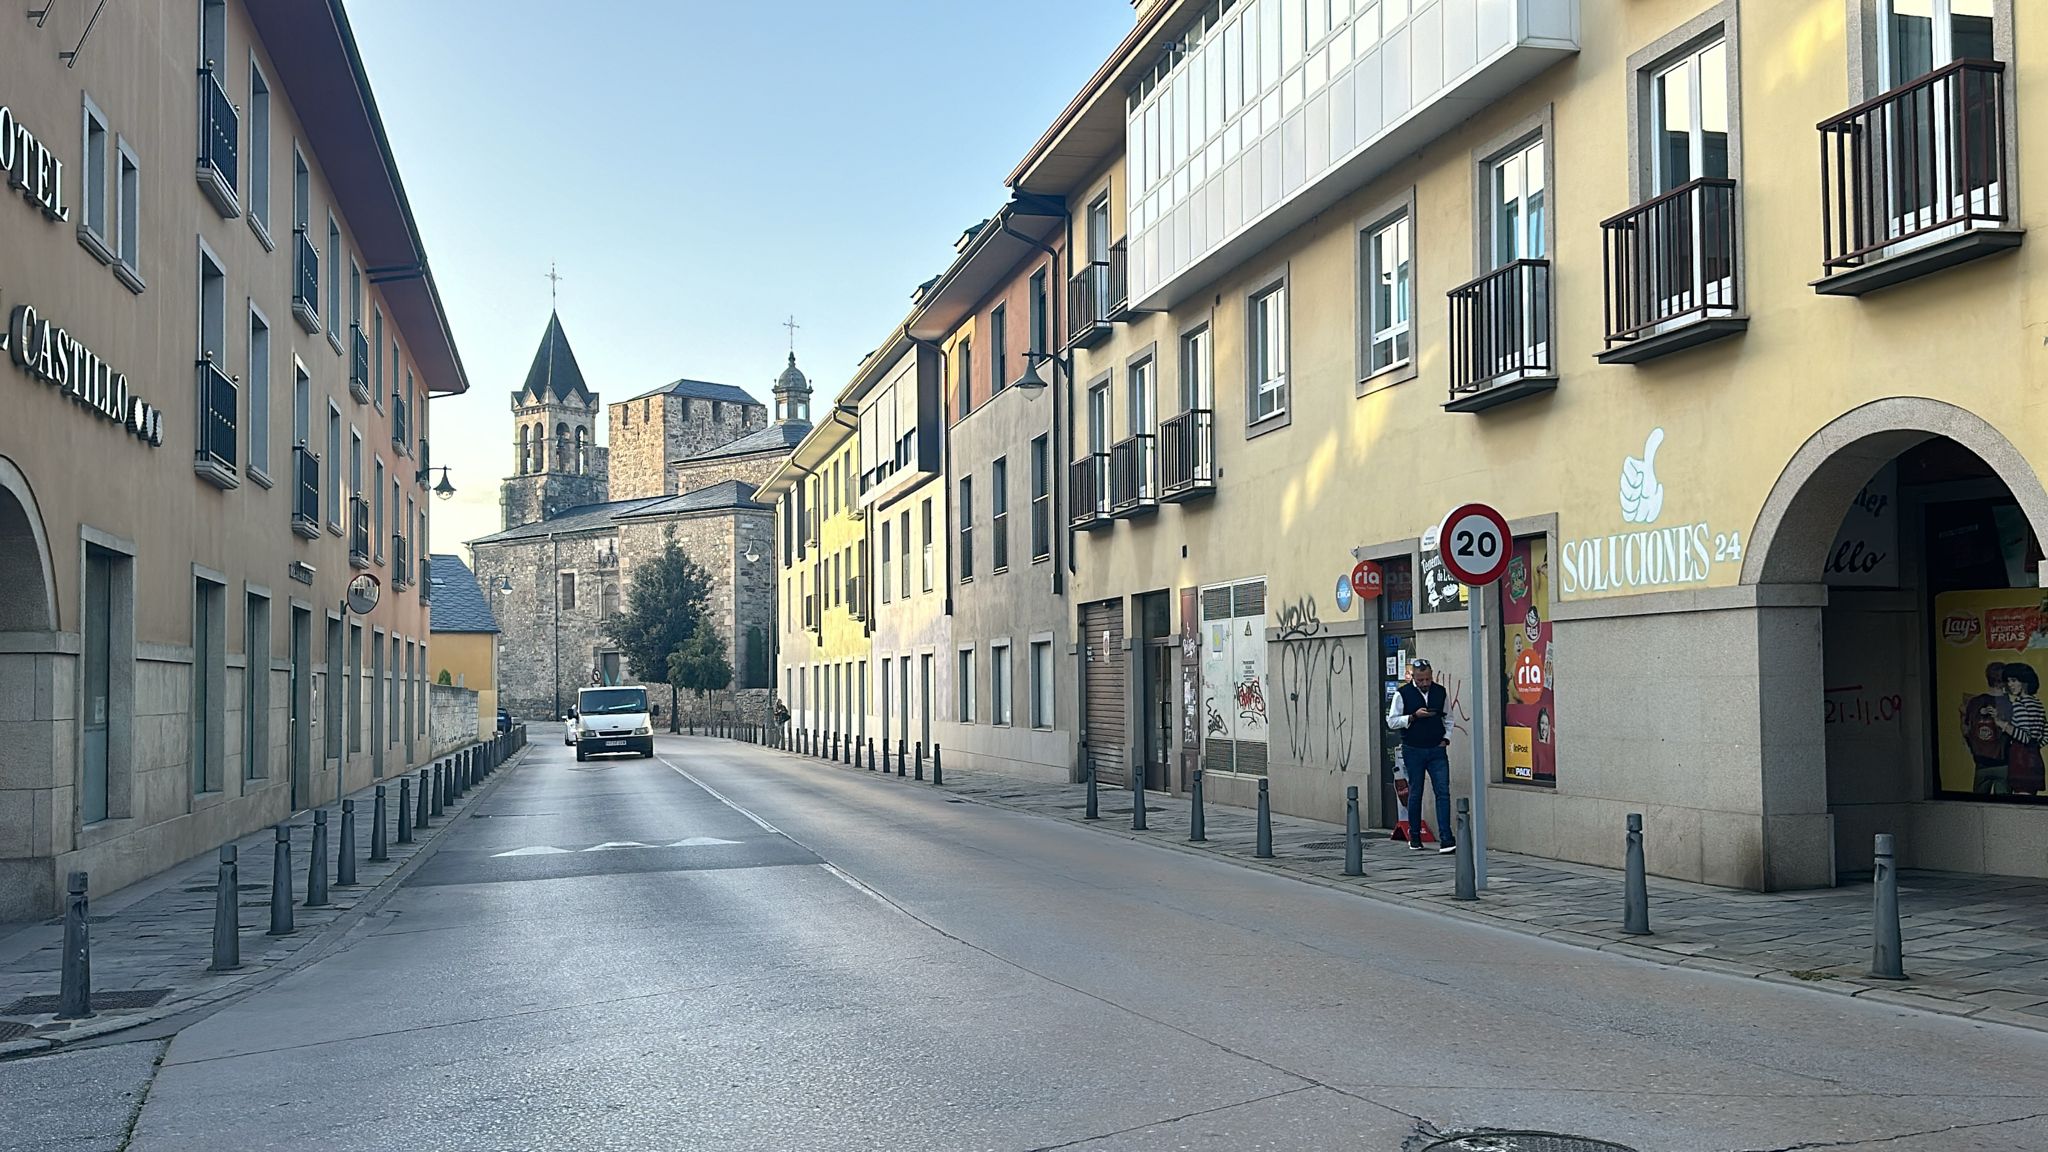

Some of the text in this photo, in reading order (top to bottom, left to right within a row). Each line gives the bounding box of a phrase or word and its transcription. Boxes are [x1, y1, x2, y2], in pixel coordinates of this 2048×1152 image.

[20, 305, 129, 424] CASTILLO
[1456, 530, 1497, 557] 20
[1561, 522, 1710, 593] SOLUCIONES
[1714, 530, 1741, 562] 24
[1354, 565, 1380, 585] ria
[1944, 617, 1978, 640] Lay's
[1518, 656, 1541, 684] ria
